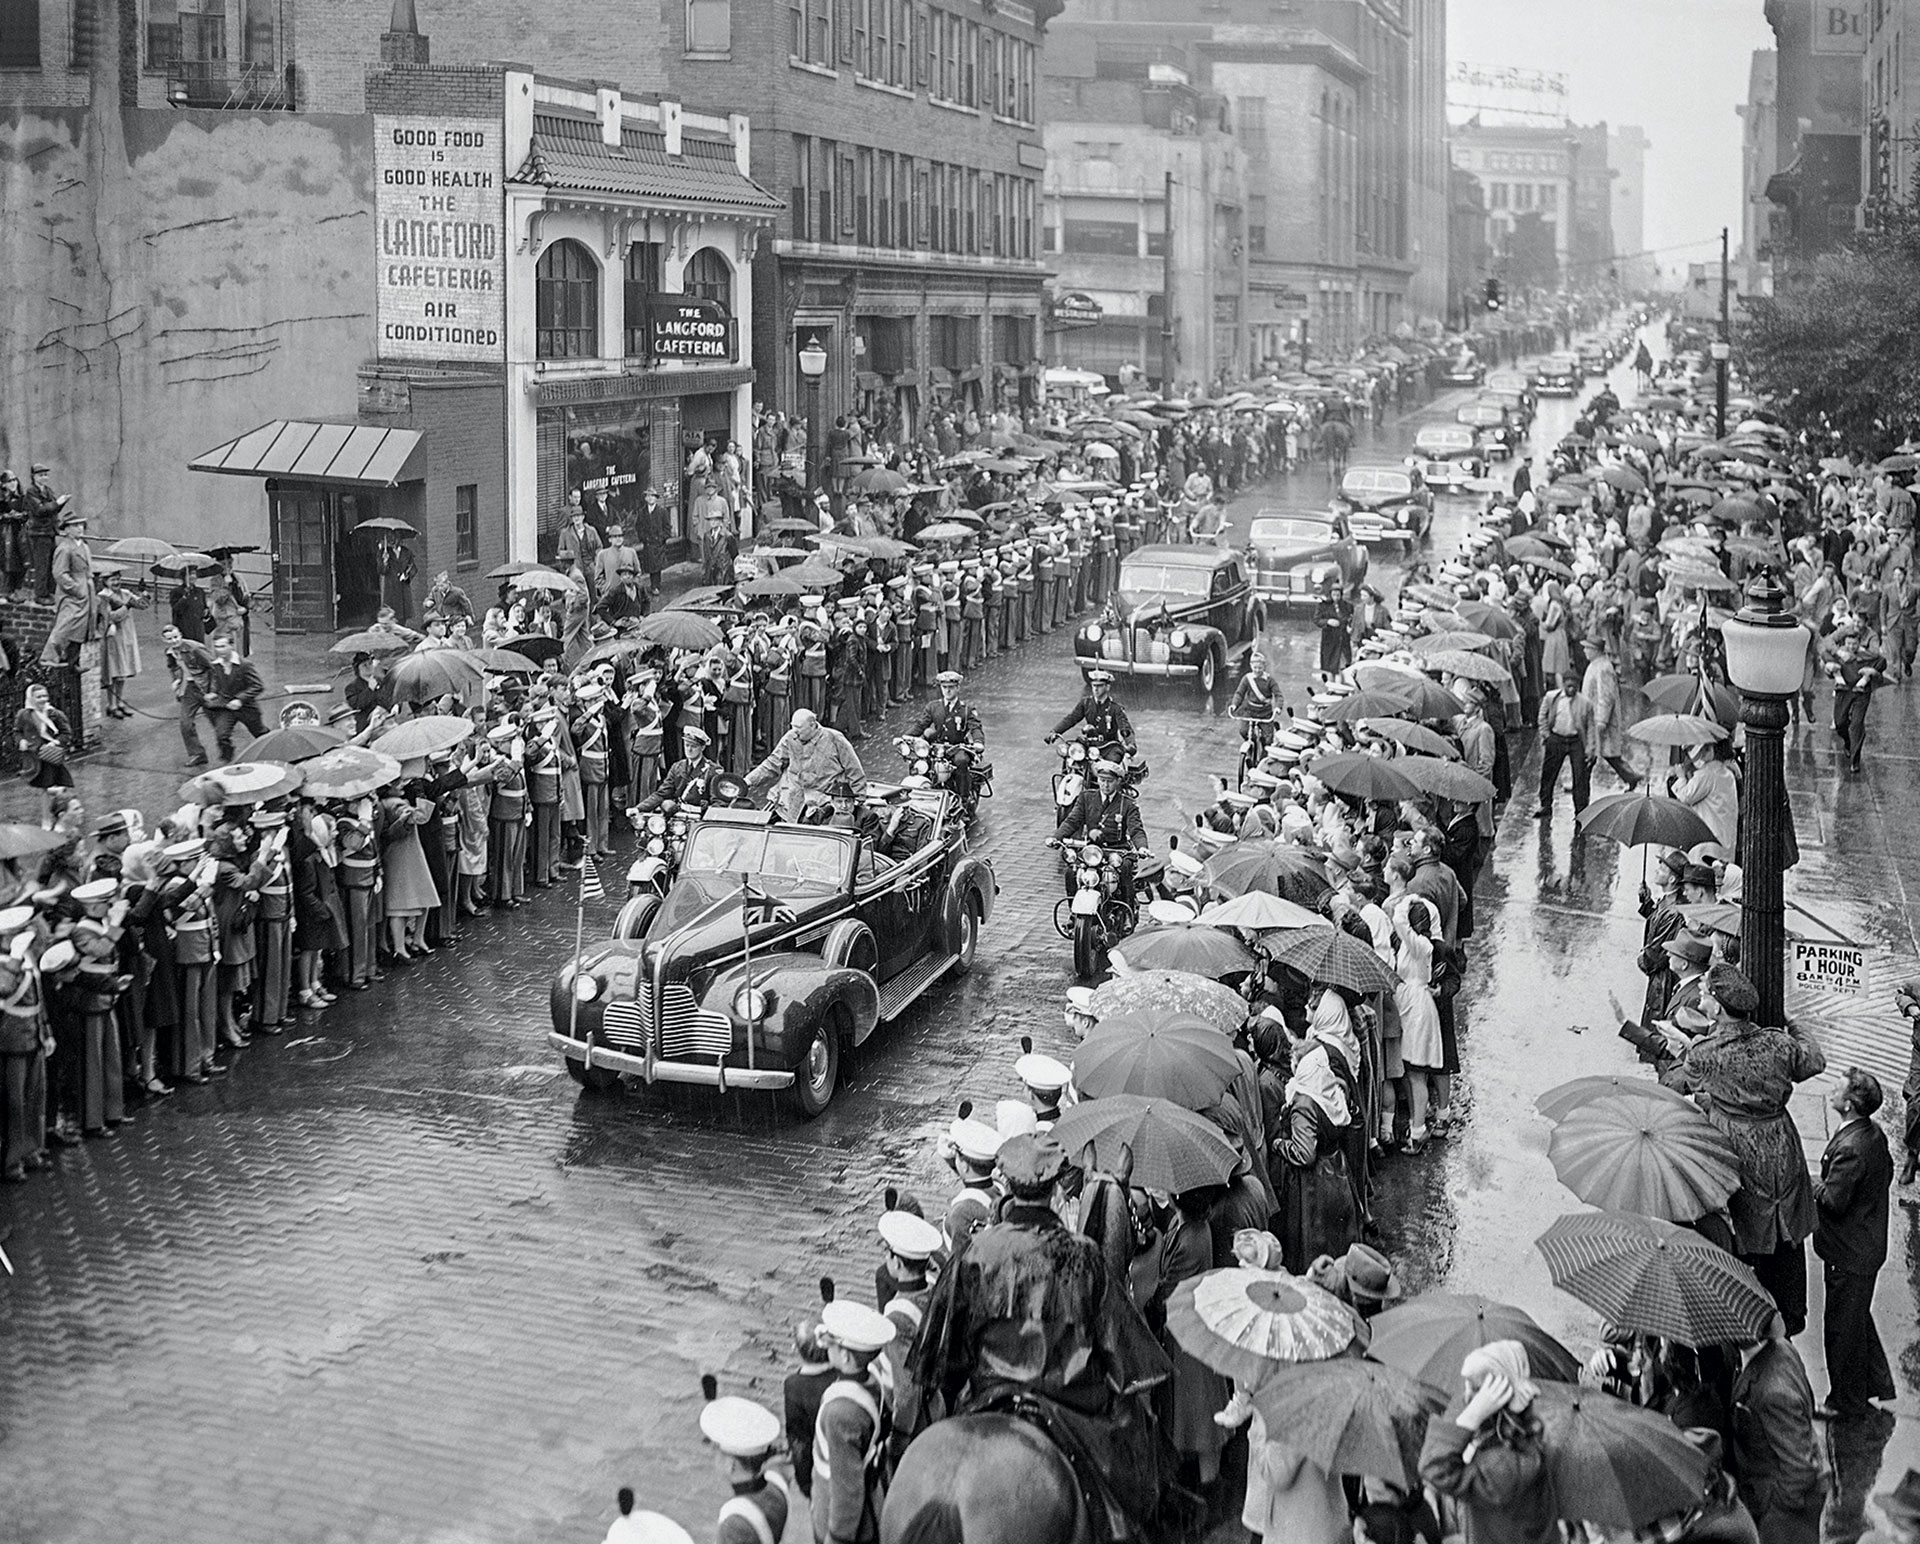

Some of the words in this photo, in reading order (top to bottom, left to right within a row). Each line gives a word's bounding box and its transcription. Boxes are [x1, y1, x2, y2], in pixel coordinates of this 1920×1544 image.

[393, 128, 437, 146] GOOD
[444, 131, 484, 148] FOOD
[431, 150, 445, 162] IS
[384, 169, 426, 186] GOOD
[432, 170, 493, 189] HEALTH
[418, 195, 457, 212] THE
[383, 218, 496, 261] LANGFORD
[388, 264, 494, 291] CAFETERIA
[424, 301, 457, 318] AIR
[678, 307, 702, 319] THE
[385, 323, 498, 346] CONDITIONED
[656, 321, 726, 338] LANGFORD
[654, 339, 726, 356] CAFETERIA
[1797, 945, 1862, 967] PARKING
[1805, 960, 1811, 971] 1
[1818, 960, 1855, 977] HOUR
